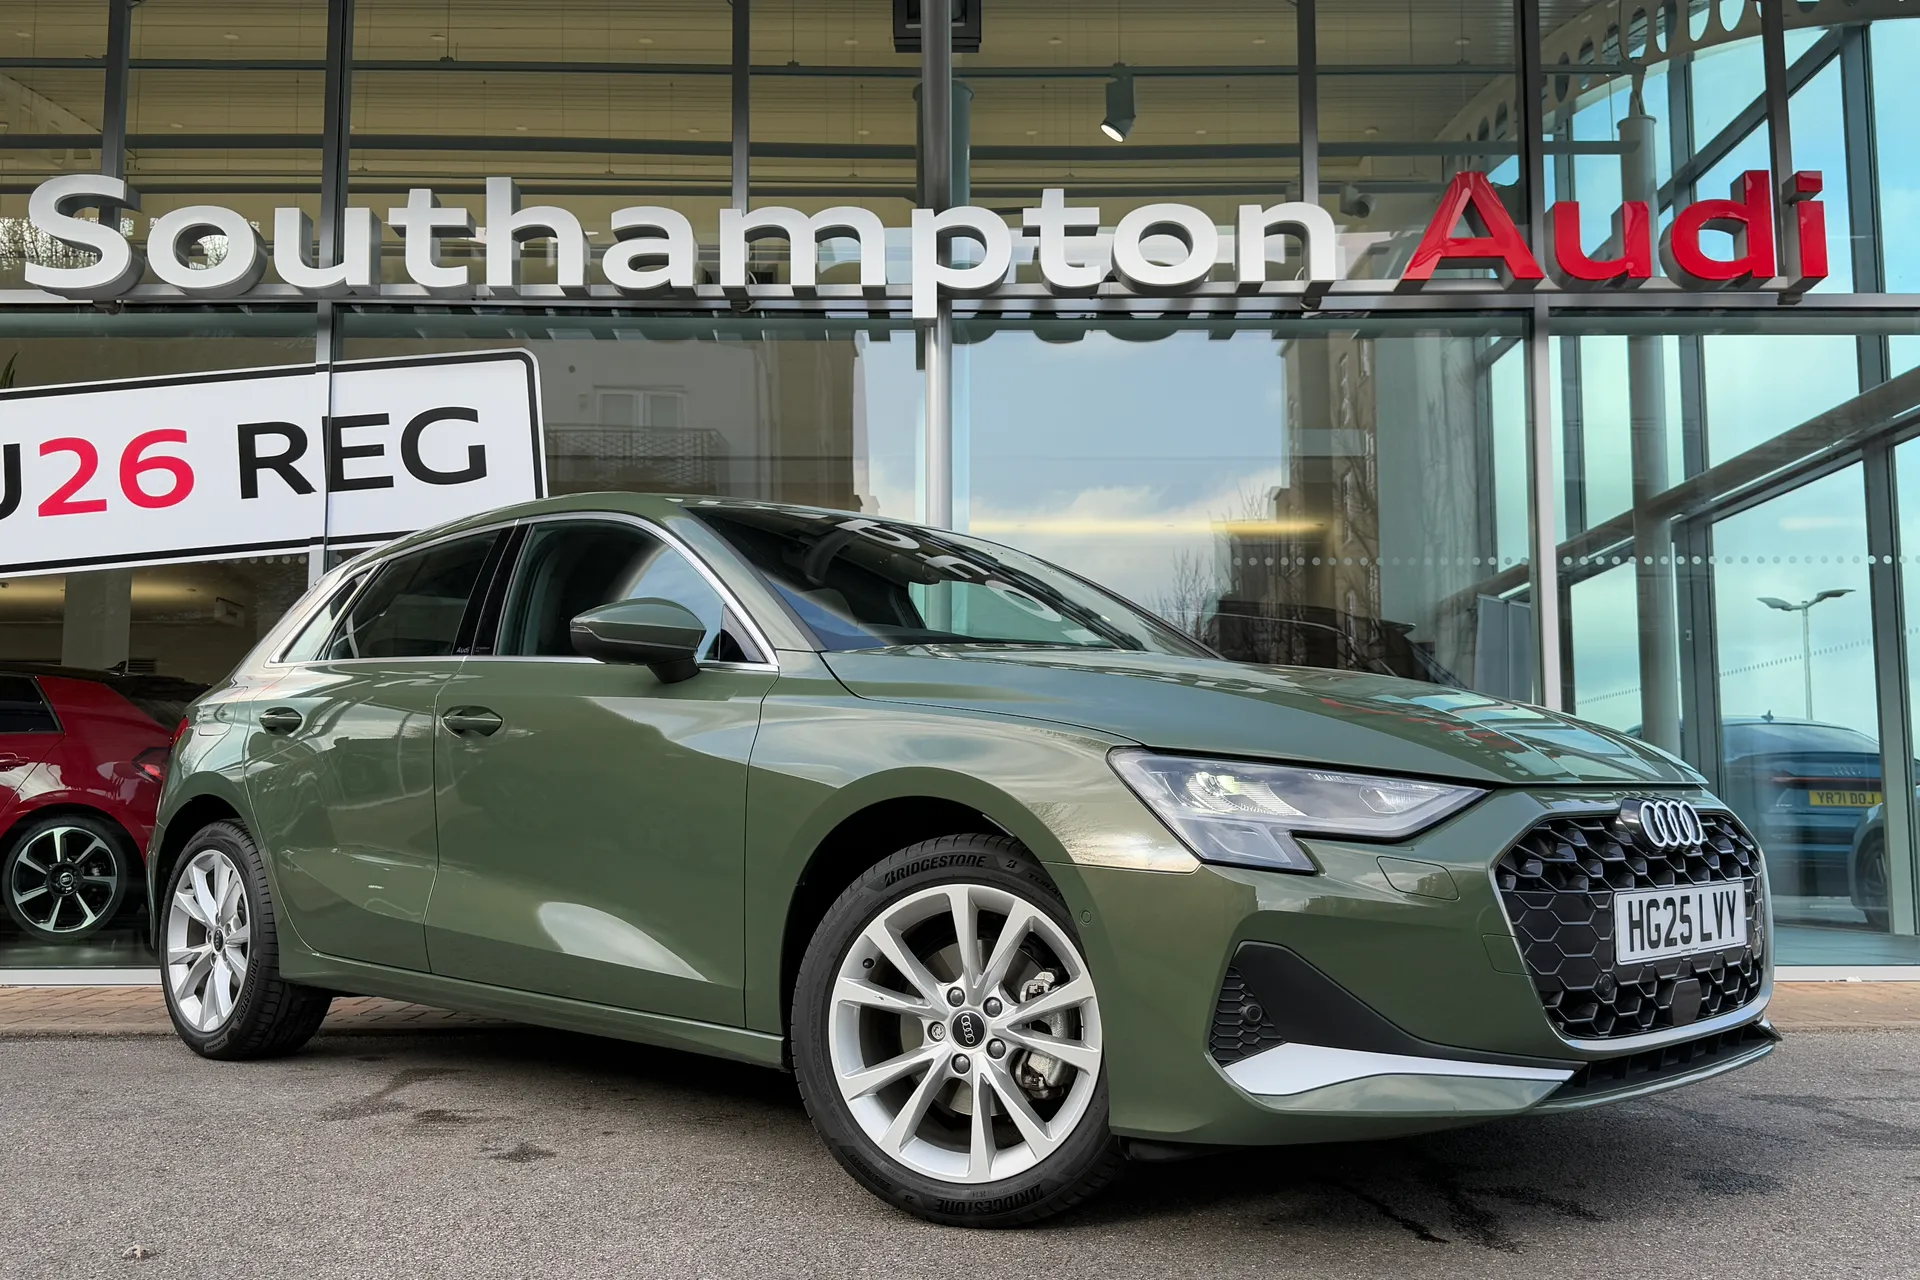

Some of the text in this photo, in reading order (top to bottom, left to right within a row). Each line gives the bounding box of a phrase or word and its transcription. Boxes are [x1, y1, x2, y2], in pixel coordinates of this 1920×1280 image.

[24, 170, 1828, 319] Southampton Audi
[236, 405, 489, 500] REG
[1816, 791, 1875, 805] YR71 DOJ
[884, 854, 987, 888] BRIDGESTONE
[1627, 889, 1737, 953] HG25 LVY
[936, 1183, 1044, 1215] BRIDGESTONE
